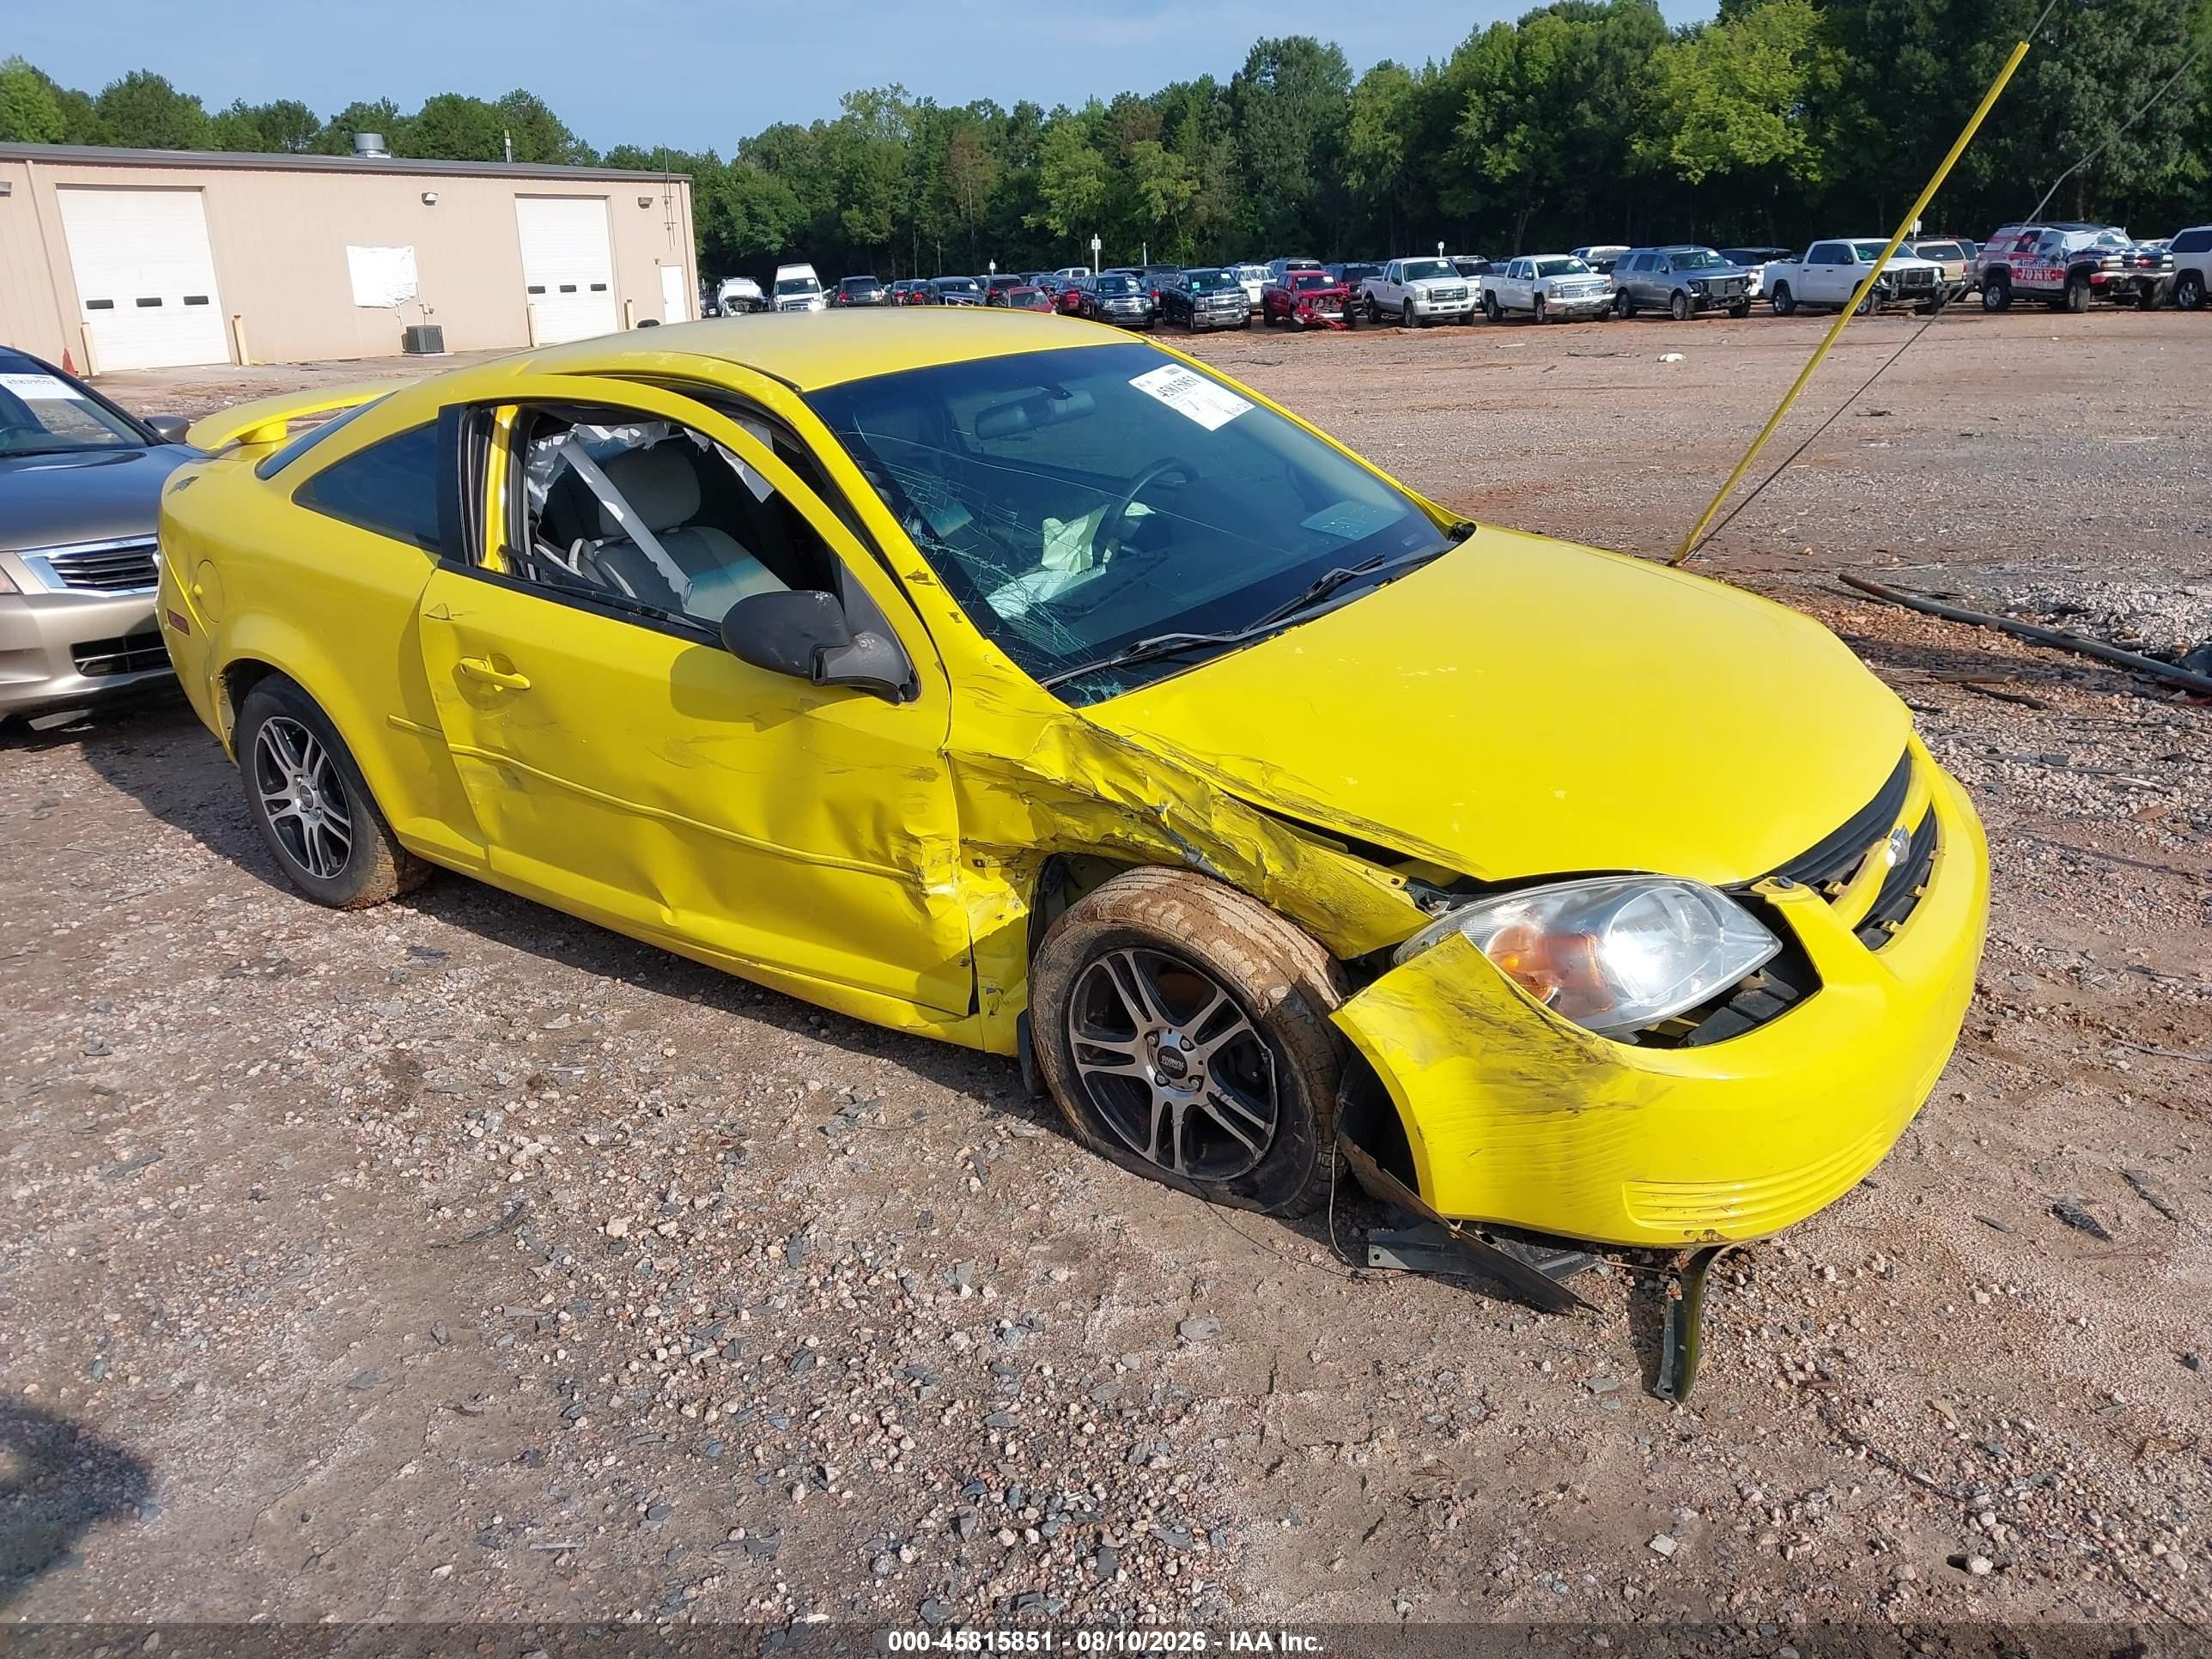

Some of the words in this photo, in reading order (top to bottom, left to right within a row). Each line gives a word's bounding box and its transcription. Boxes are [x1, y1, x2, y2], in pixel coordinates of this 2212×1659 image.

[2018, 259, 2057, 269] American
[2021, 268, 2052, 281] JUNK
[1156, 375, 1201, 398] 45815851
